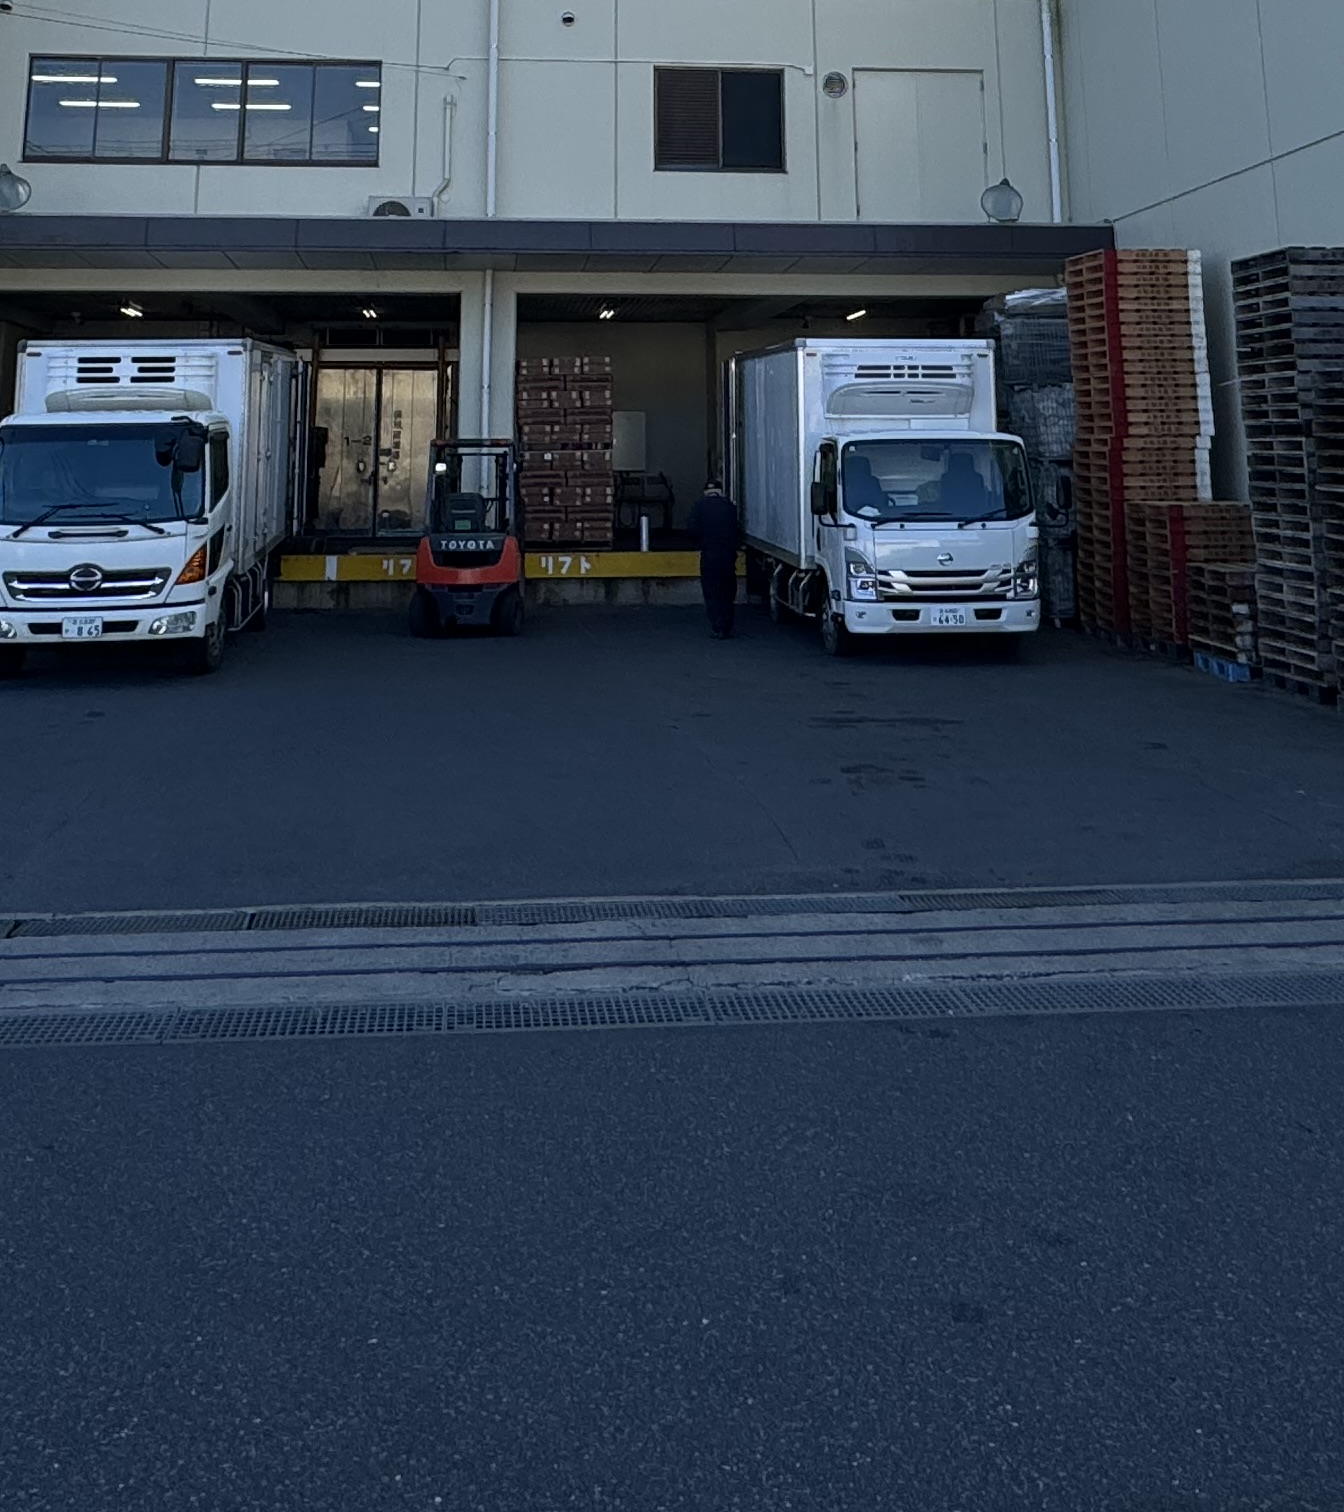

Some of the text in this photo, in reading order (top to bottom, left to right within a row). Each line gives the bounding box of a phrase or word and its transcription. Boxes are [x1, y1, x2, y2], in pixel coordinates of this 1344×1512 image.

[440, 539, 495, 550] TOYOTA
[381, 558, 413, 576] リフ
[540, 556, 592, 575] リフト
